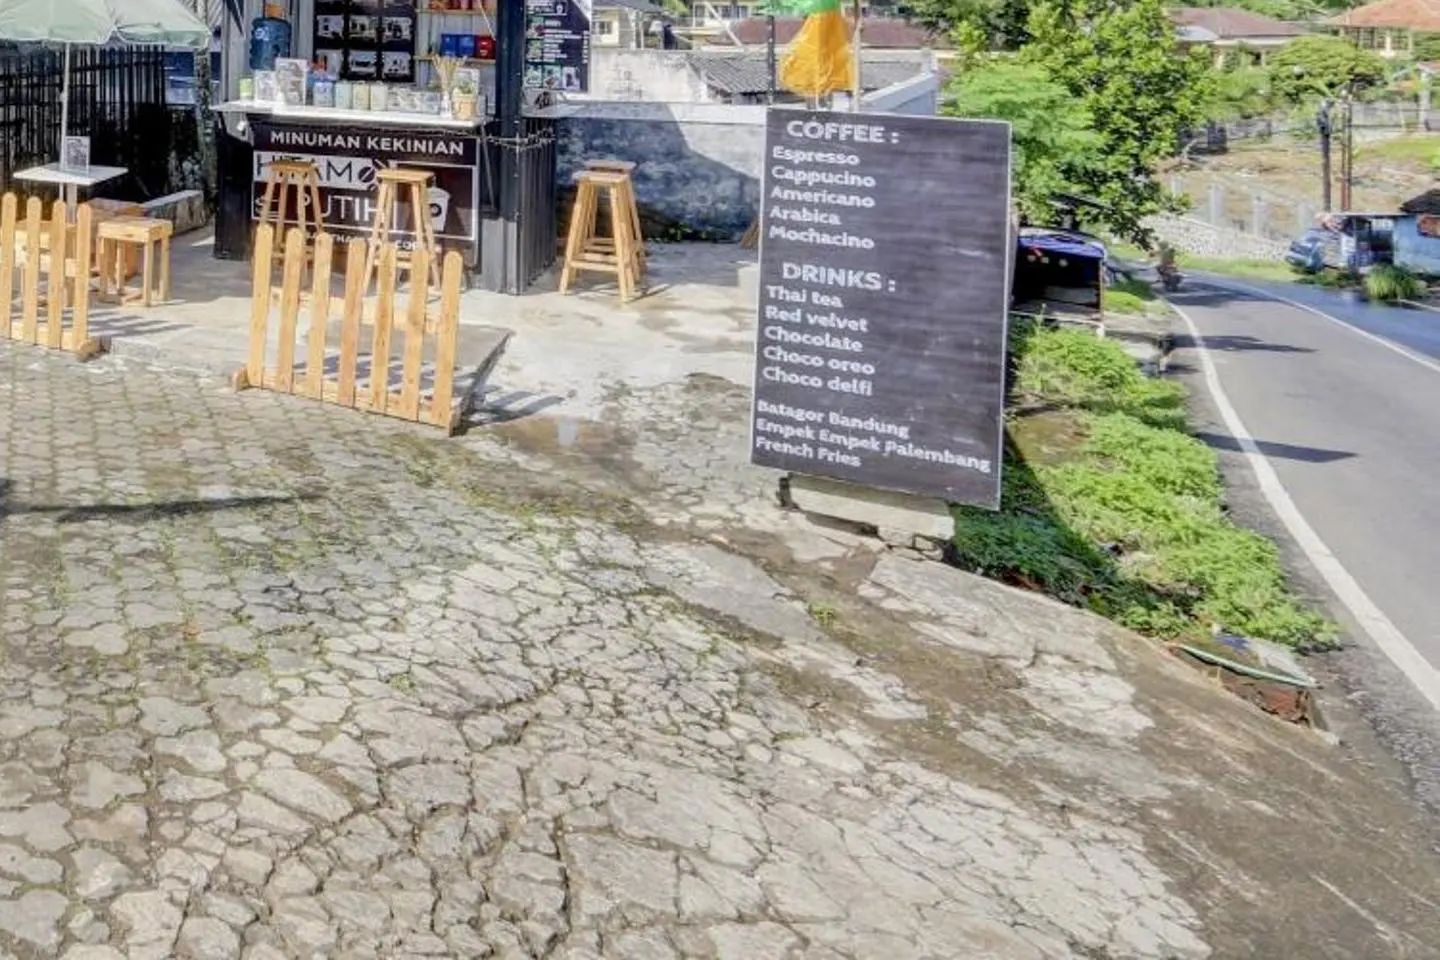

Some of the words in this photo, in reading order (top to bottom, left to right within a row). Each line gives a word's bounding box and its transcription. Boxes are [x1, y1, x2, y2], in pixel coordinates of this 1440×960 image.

[271, 130, 360, 149] MINUMAN
[367, 136, 464, 156] KEKINIAN
[772, 145, 860, 165] Espresso
[256, 154, 352, 182] HAM
[771, 166, 876, 187] Cappucino
[770, 185, 875, 208] Americano
[770, 205, 841, 225] Arabica
[769, 225, 875, 249] Mochacino
[766, 284, 807, 302] Thai
[811, 291, 843, 308] tea
[765, 305, 801, 322] Red
[806, 312, 868, 332] velvet
[764, 325, 863, 352] Chocolate
[763, 345, 824, 367] Choco
[827, 358, 875, 375] oreo
[763, 366, 822, 387] Choco
[827, 376, 872, 396] delfi
[757, 400, 824, 423] Batagor
[829, 411, 909, 439] Bandung
[756, 419, 816, 440] Empek
[819, 428, 880, 451] Empek
[884, 440, 992, 473] Palembang
[756, 436, 813, 458] French
[817, 447, 862, 468] Fries
